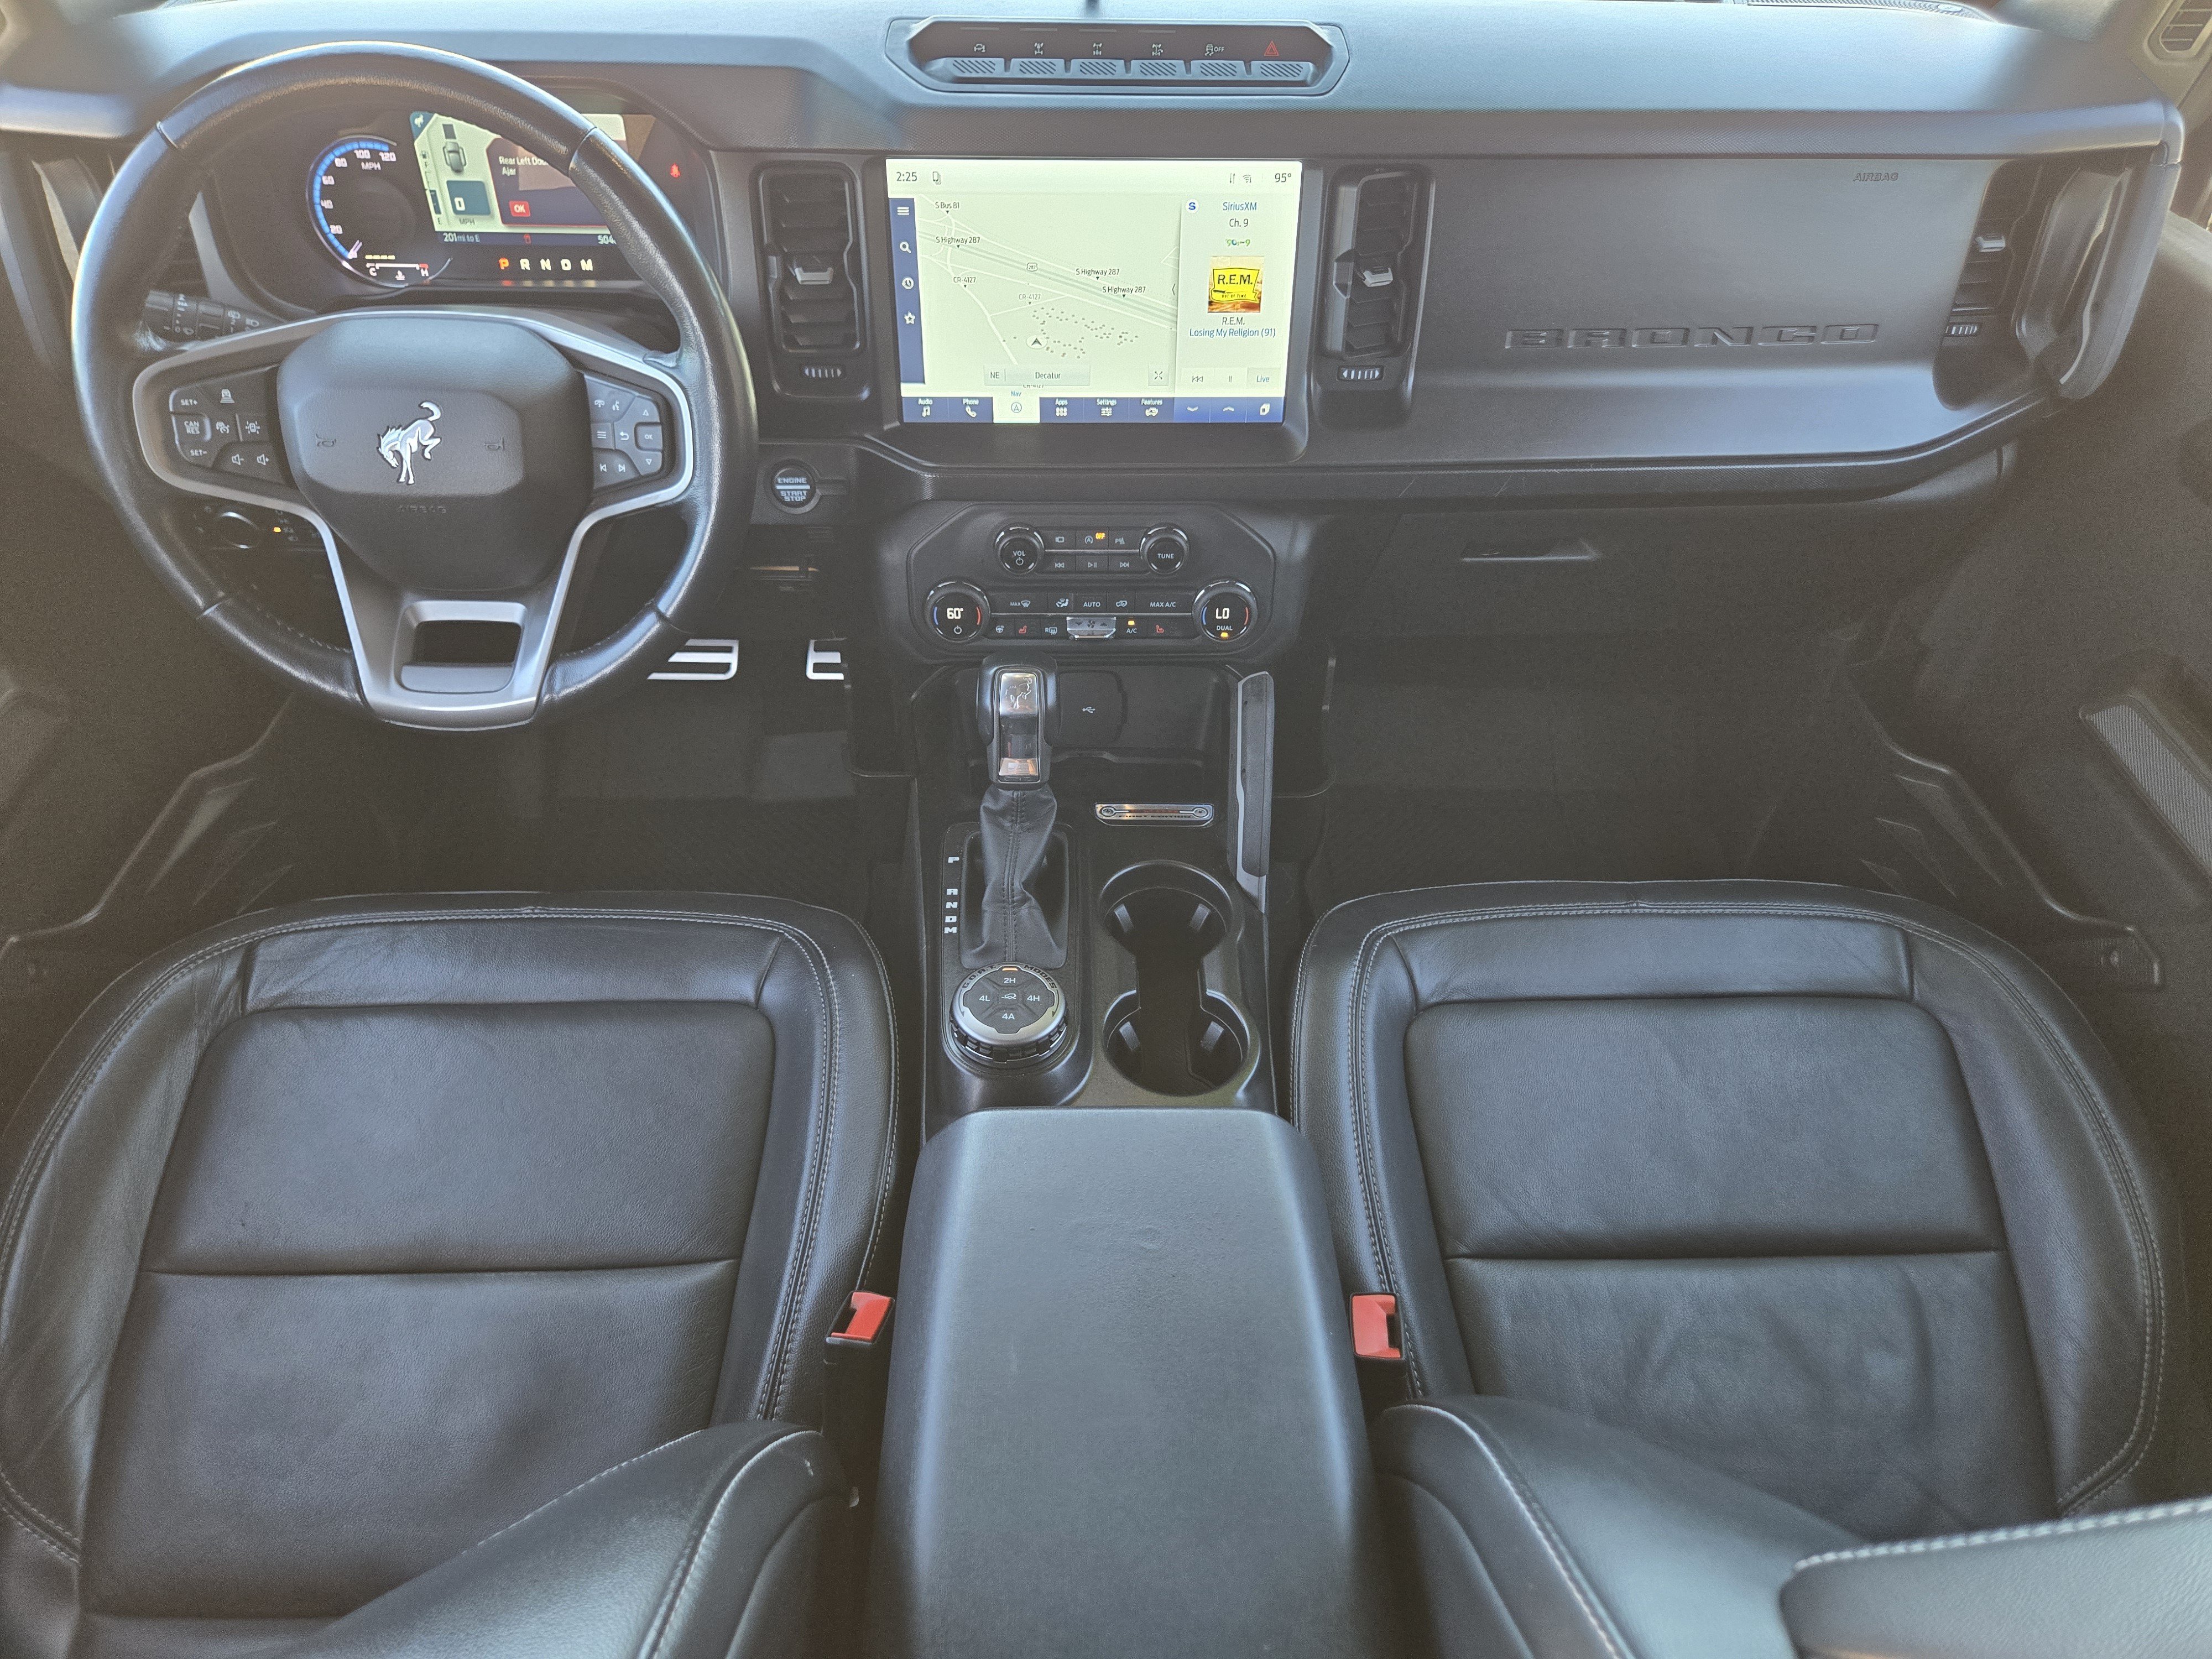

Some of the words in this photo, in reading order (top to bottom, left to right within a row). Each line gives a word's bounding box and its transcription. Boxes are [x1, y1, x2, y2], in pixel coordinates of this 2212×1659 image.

[354, 149, 371, 159] 100
[379, 152, 397, 161] 120
[499, 156, 515, 165] Rear
[517, 156, 531, 165] Left
[502, 166, 516, 176] Ajar
[896, 171, 917, 182] 2:25
[1275, 173, 1292, 182] 95°
[1853, 173, 1898, 181] AIRBAG
[454, 197, 466, 211] 0
[514, 204, 526, 213] OK
[1223, 202, 1257, 211] SiriusXM
[1229, 218, 1241, 227] Ch.
[1244, 218, 1249, 227] 9
[443, 232, 457, 242] 201
[467, 234, 474, 242] to
[475, 234, 481, 242] E
[941, 236, 968, 245] Highway
[499, 257, 509, 270] P
[519, 258, 530, 270] R
[540, 258, 551, 270] N
[560, 259, 572, 270] D
[581, 259, 593, 271] M
[1081, 268, 1108, 278] Highway
[1218, 274, 1253, 285] R.E.M.
[1108, 286, 1134, 295] Highway
[1222, 317, 1245, 325] R.E.M.
[1190, 328, 1214, 338] Losing
[1216, 328, 1227, 338] My
[1228, 328, 1259, 338] Religion
[1261, 328, 1276, 338] (91)
[1504, 324, 1879, 349] BRONCO
[1215, 608, 1230, 619] LO
[1024, 964, 1057, 989] MODES
